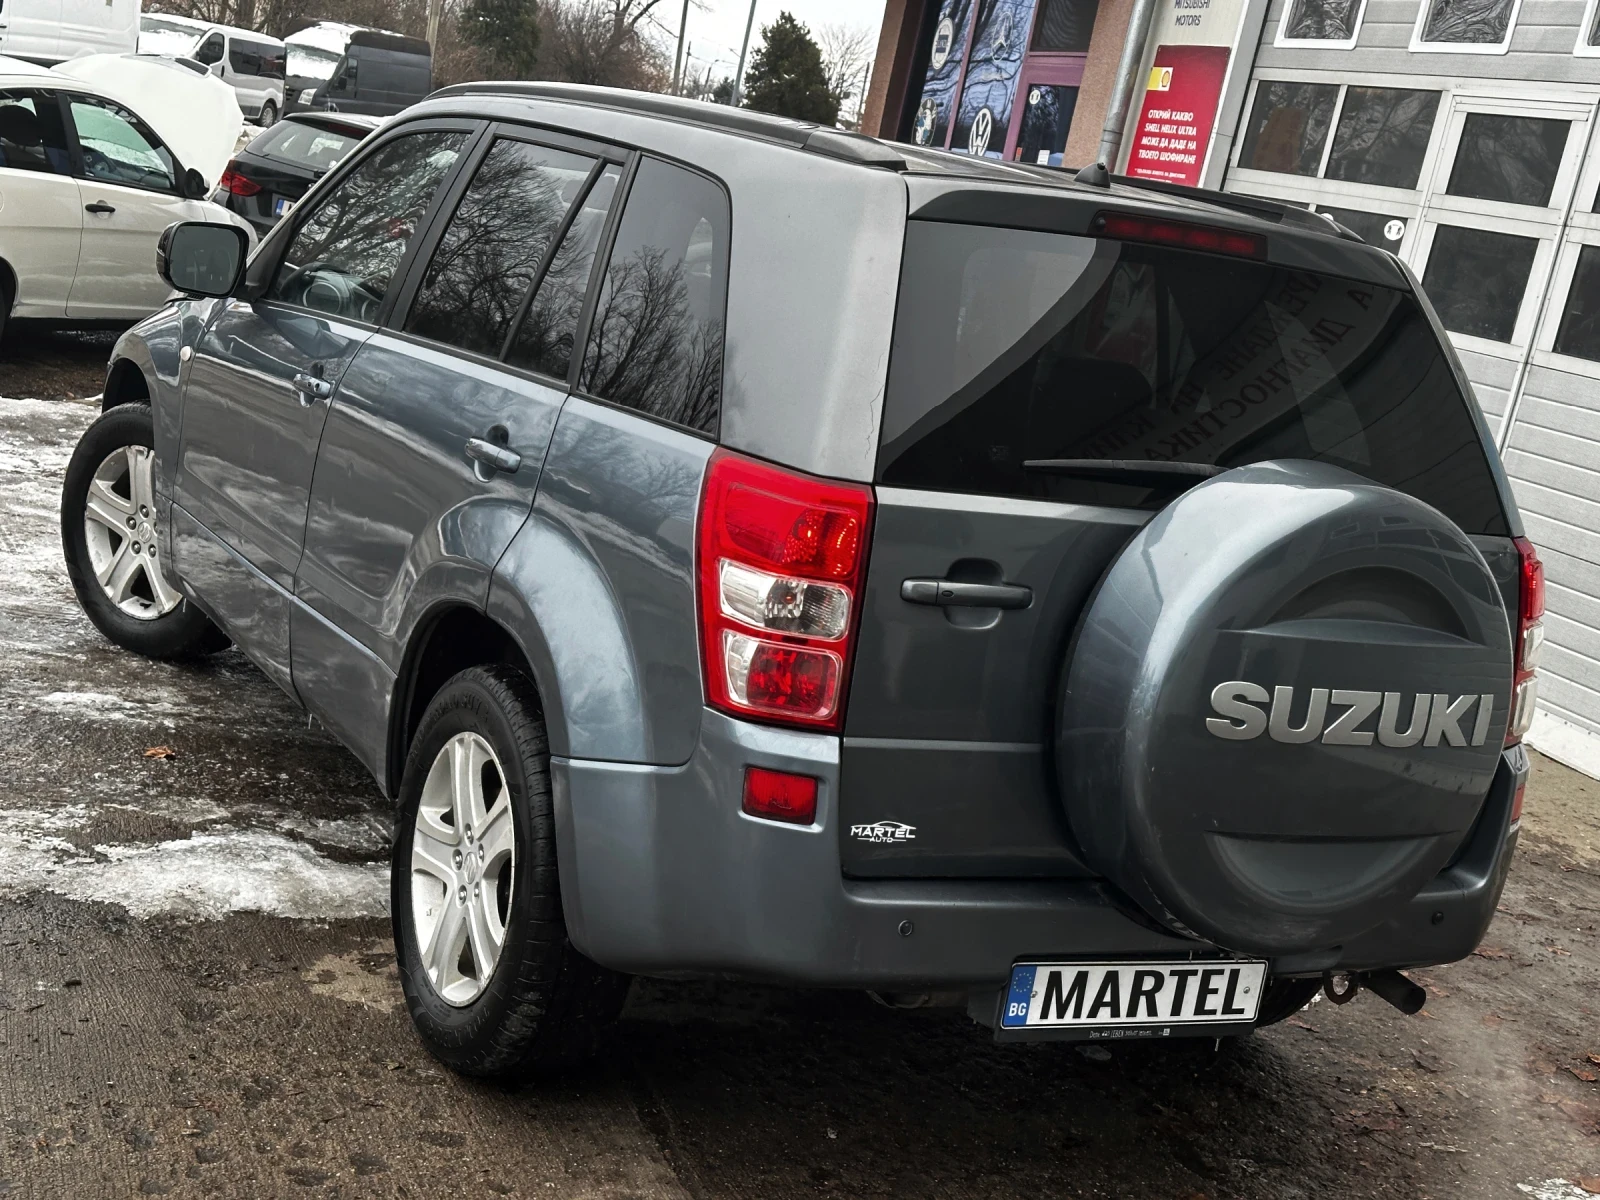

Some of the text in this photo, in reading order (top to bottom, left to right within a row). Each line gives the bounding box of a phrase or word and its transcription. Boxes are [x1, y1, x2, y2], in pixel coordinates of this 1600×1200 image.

[1174, 0, 1210, 9] MITSUBISHI
[1175, 14, 1202, 26] MOTORS
[1148, 109, 1194, 122] ОТКРИЙ КАКВО
[1144, 122, 1197, 136] SHELL HELIX ULTRA
[1141, 136, 1197, 150] МОЖЕ ДА ДАДЕ НА
[1138, 149, 1197, 165] ТВОЕТО ШОФИРАНЕ
[1206, 681, 1494, 748] SUZUKI
[850, 826, 916, 839] MARTEL
[1008, 968, 1246, 1020] BG MARTEL
